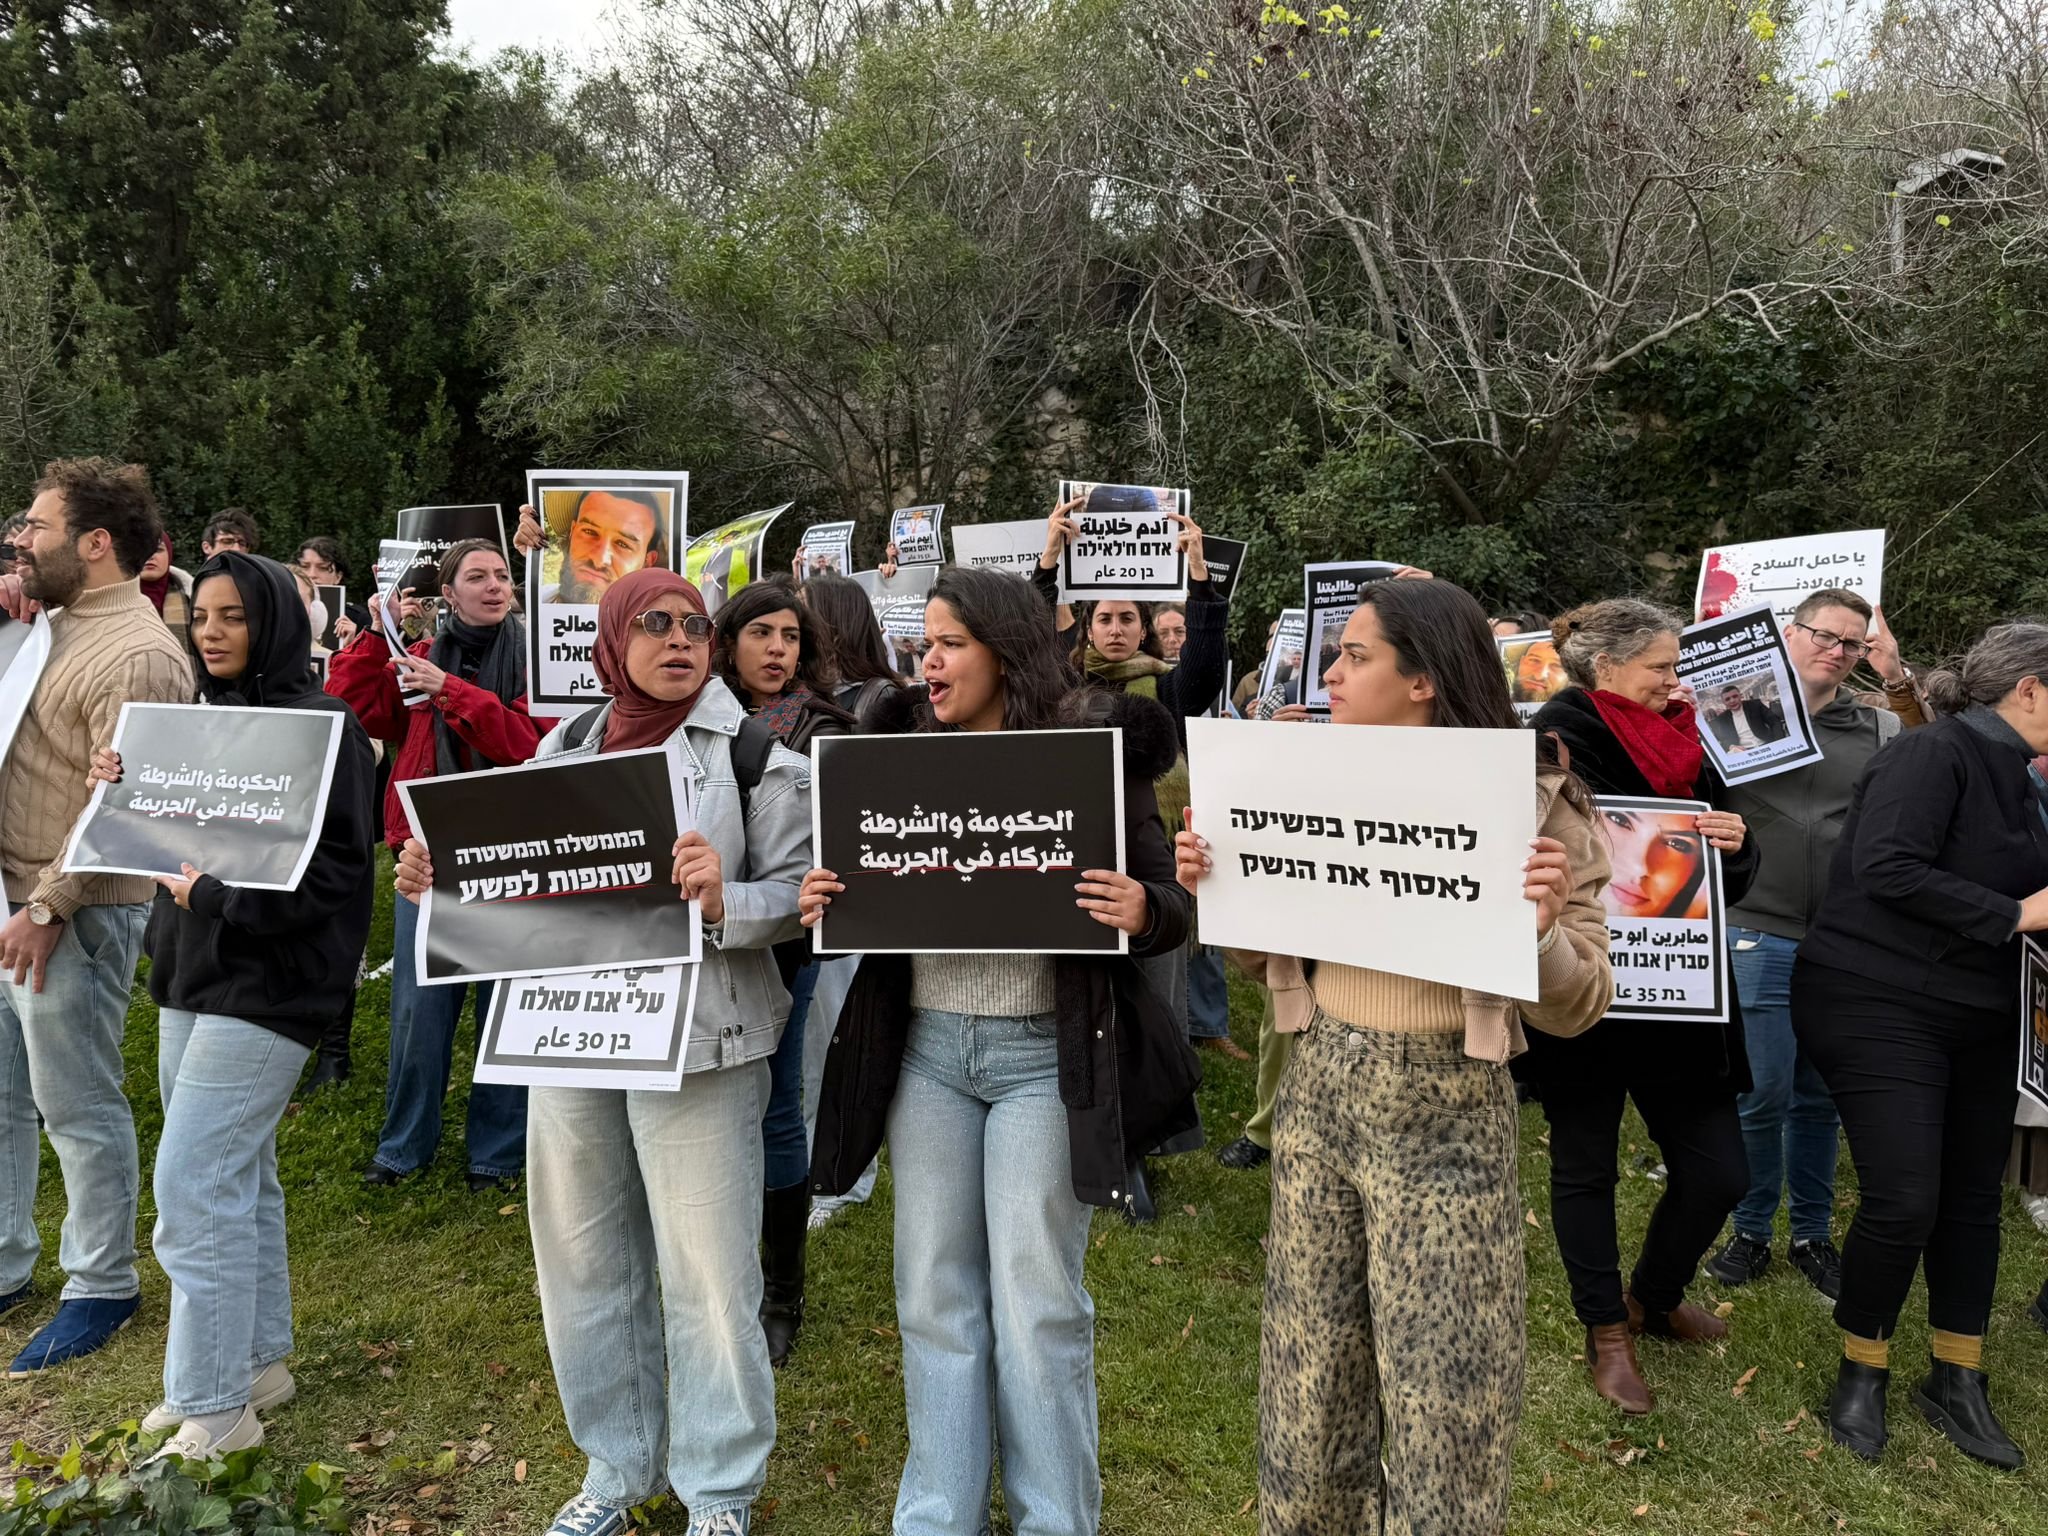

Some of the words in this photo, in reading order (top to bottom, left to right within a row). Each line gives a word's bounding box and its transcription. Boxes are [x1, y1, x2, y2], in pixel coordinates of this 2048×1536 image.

[1080, 517, 1132, 540] خلايلة
[1136, 517, 1169, 539] آدم
[971, 554, 1014, 565] בפשיעה
[1140, 542, 1172, 556] אדם
[1853, 552, 1865, 567] يا
[1095, 564, 1116, 581] عام
[1120, 567, 1136, 577] 20
[1141, 567, 1154, 580] בן
[1751, 556, 1804, 576] السلاح
[1806, 554, 1849, 570] حامل
[553, 615, 597, 637] صالح
[1752, 621, 1769, 640] اخ
[1717, 627, 1752, 650] احدى
[569, 673, 596, 695] عام
[139, 763, 213, 792] والشرطة
[215, 768, 292, 794] الحكومة
[129, 791, 196, 818] الجريمة
[196, 796, 228, 826] في
[228, 797, 285, 824] شركاء
[860, 804, 964, 840] والشرطة
[967, 808, 1074, 839] الحكومة
[1230, 808, 1345, 838] בפשיעה
[554, 829, 646, 853] הממשלה
[1354, 819, 1478, 851] להיאבק
[455, 839, 550, 865] והמשטרה
[859, 844, 948, 877] الجريمة
[953, 842, 994, 882] في
[999, 837, 1074, 873] شركاء
[548, 861, 653, 893] שותפות
[1239, 853, 1316, 881] הנשק
[1326, 863, 1370, 888] את
[459, 868, 539, 904] לפשע
[1379, 869, 1481, 902] לאסוף
[1627, 926, 1647, 946] ابو
[1652, 928, 1708, 947] صابرين
[1633, 952, 1661, 968] אבו
[1665, 954, 1709, 972] סברין
[519, 986, 581, 1012] סאלח
[584, 991, 622, 1013] אבו
[626, 988, 665, 1014] עלי
[1616, 983, 1632, 998] عا
[1637, 987, 1657, 1002] 35
[1661, 988, 1687, 1001] בת
[533, 1026, 570, 1055] عام
[575, 1032, 604, 1052] 30
[609, 1032, 631, 1055] בן
